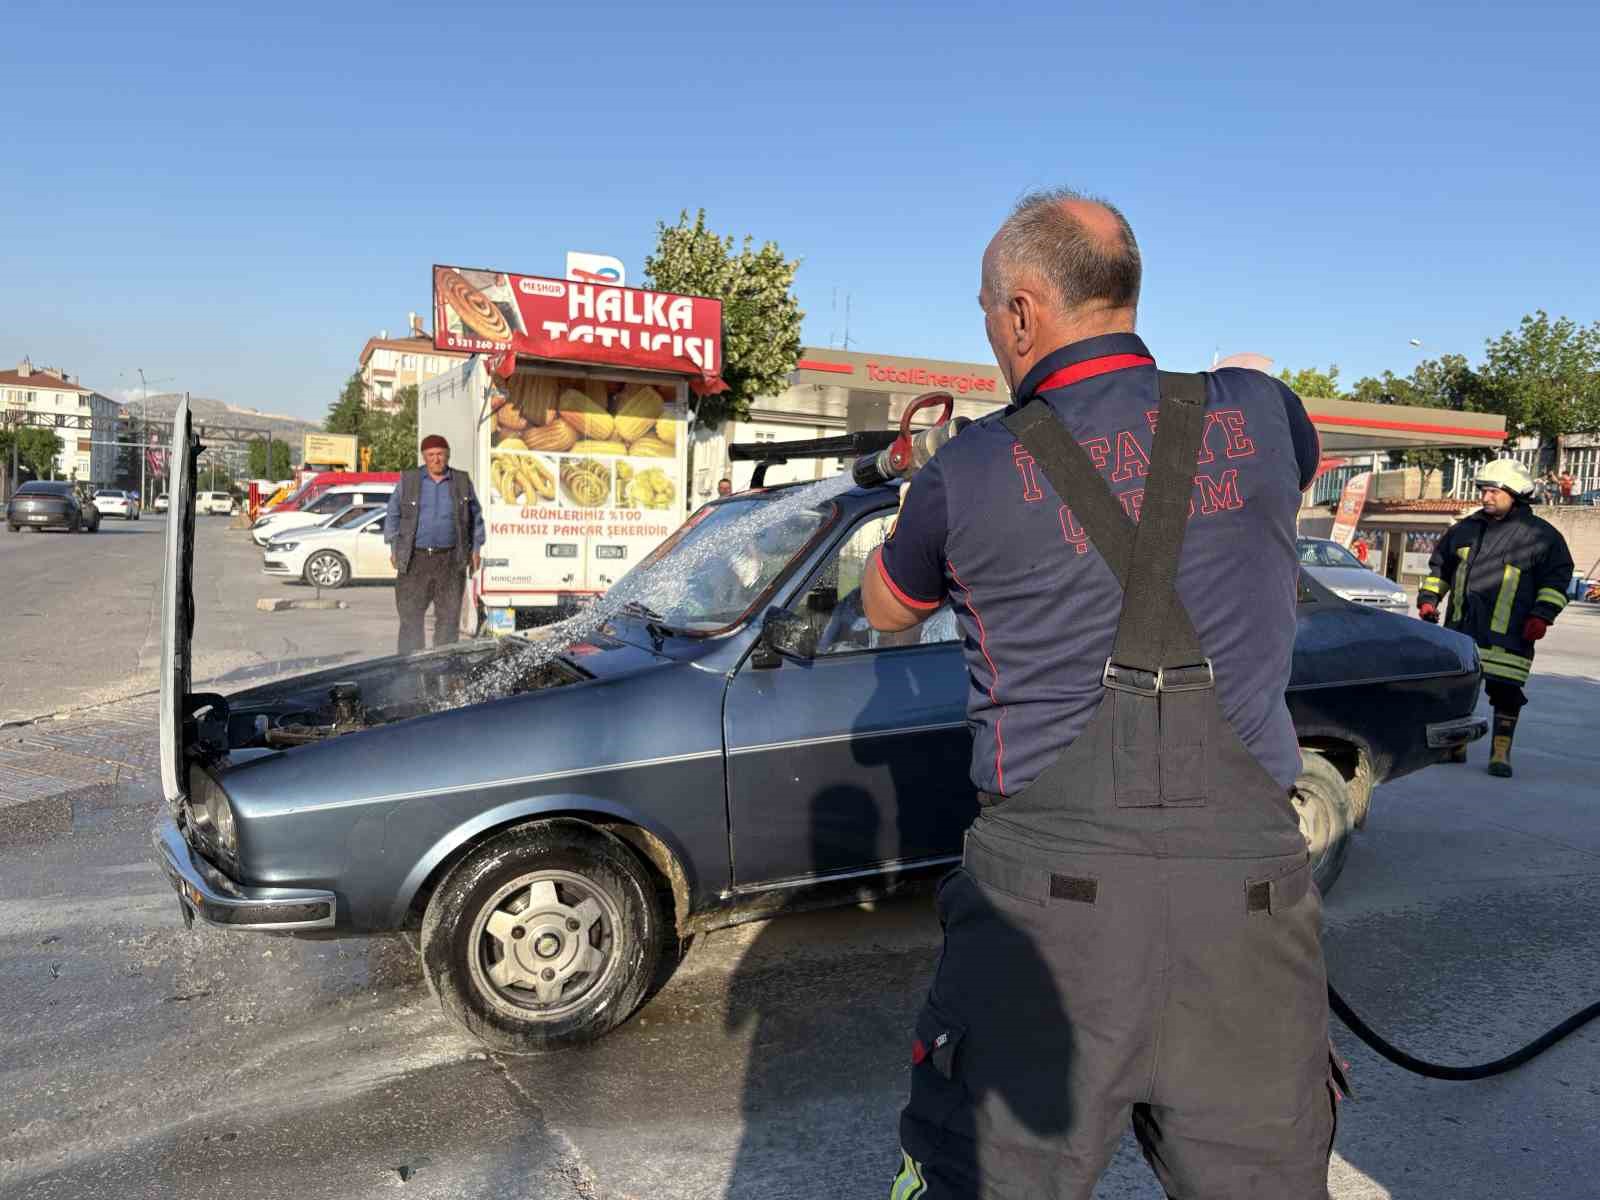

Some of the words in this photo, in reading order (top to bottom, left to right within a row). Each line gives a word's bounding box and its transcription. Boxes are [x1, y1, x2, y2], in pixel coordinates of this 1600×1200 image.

[568, 284, 693, 331] HALKA
[866, 361, 998, 393] TotalEnergies
[608, 510, 642, 521] %100
[553, 525, 603, 537] PANCAR
